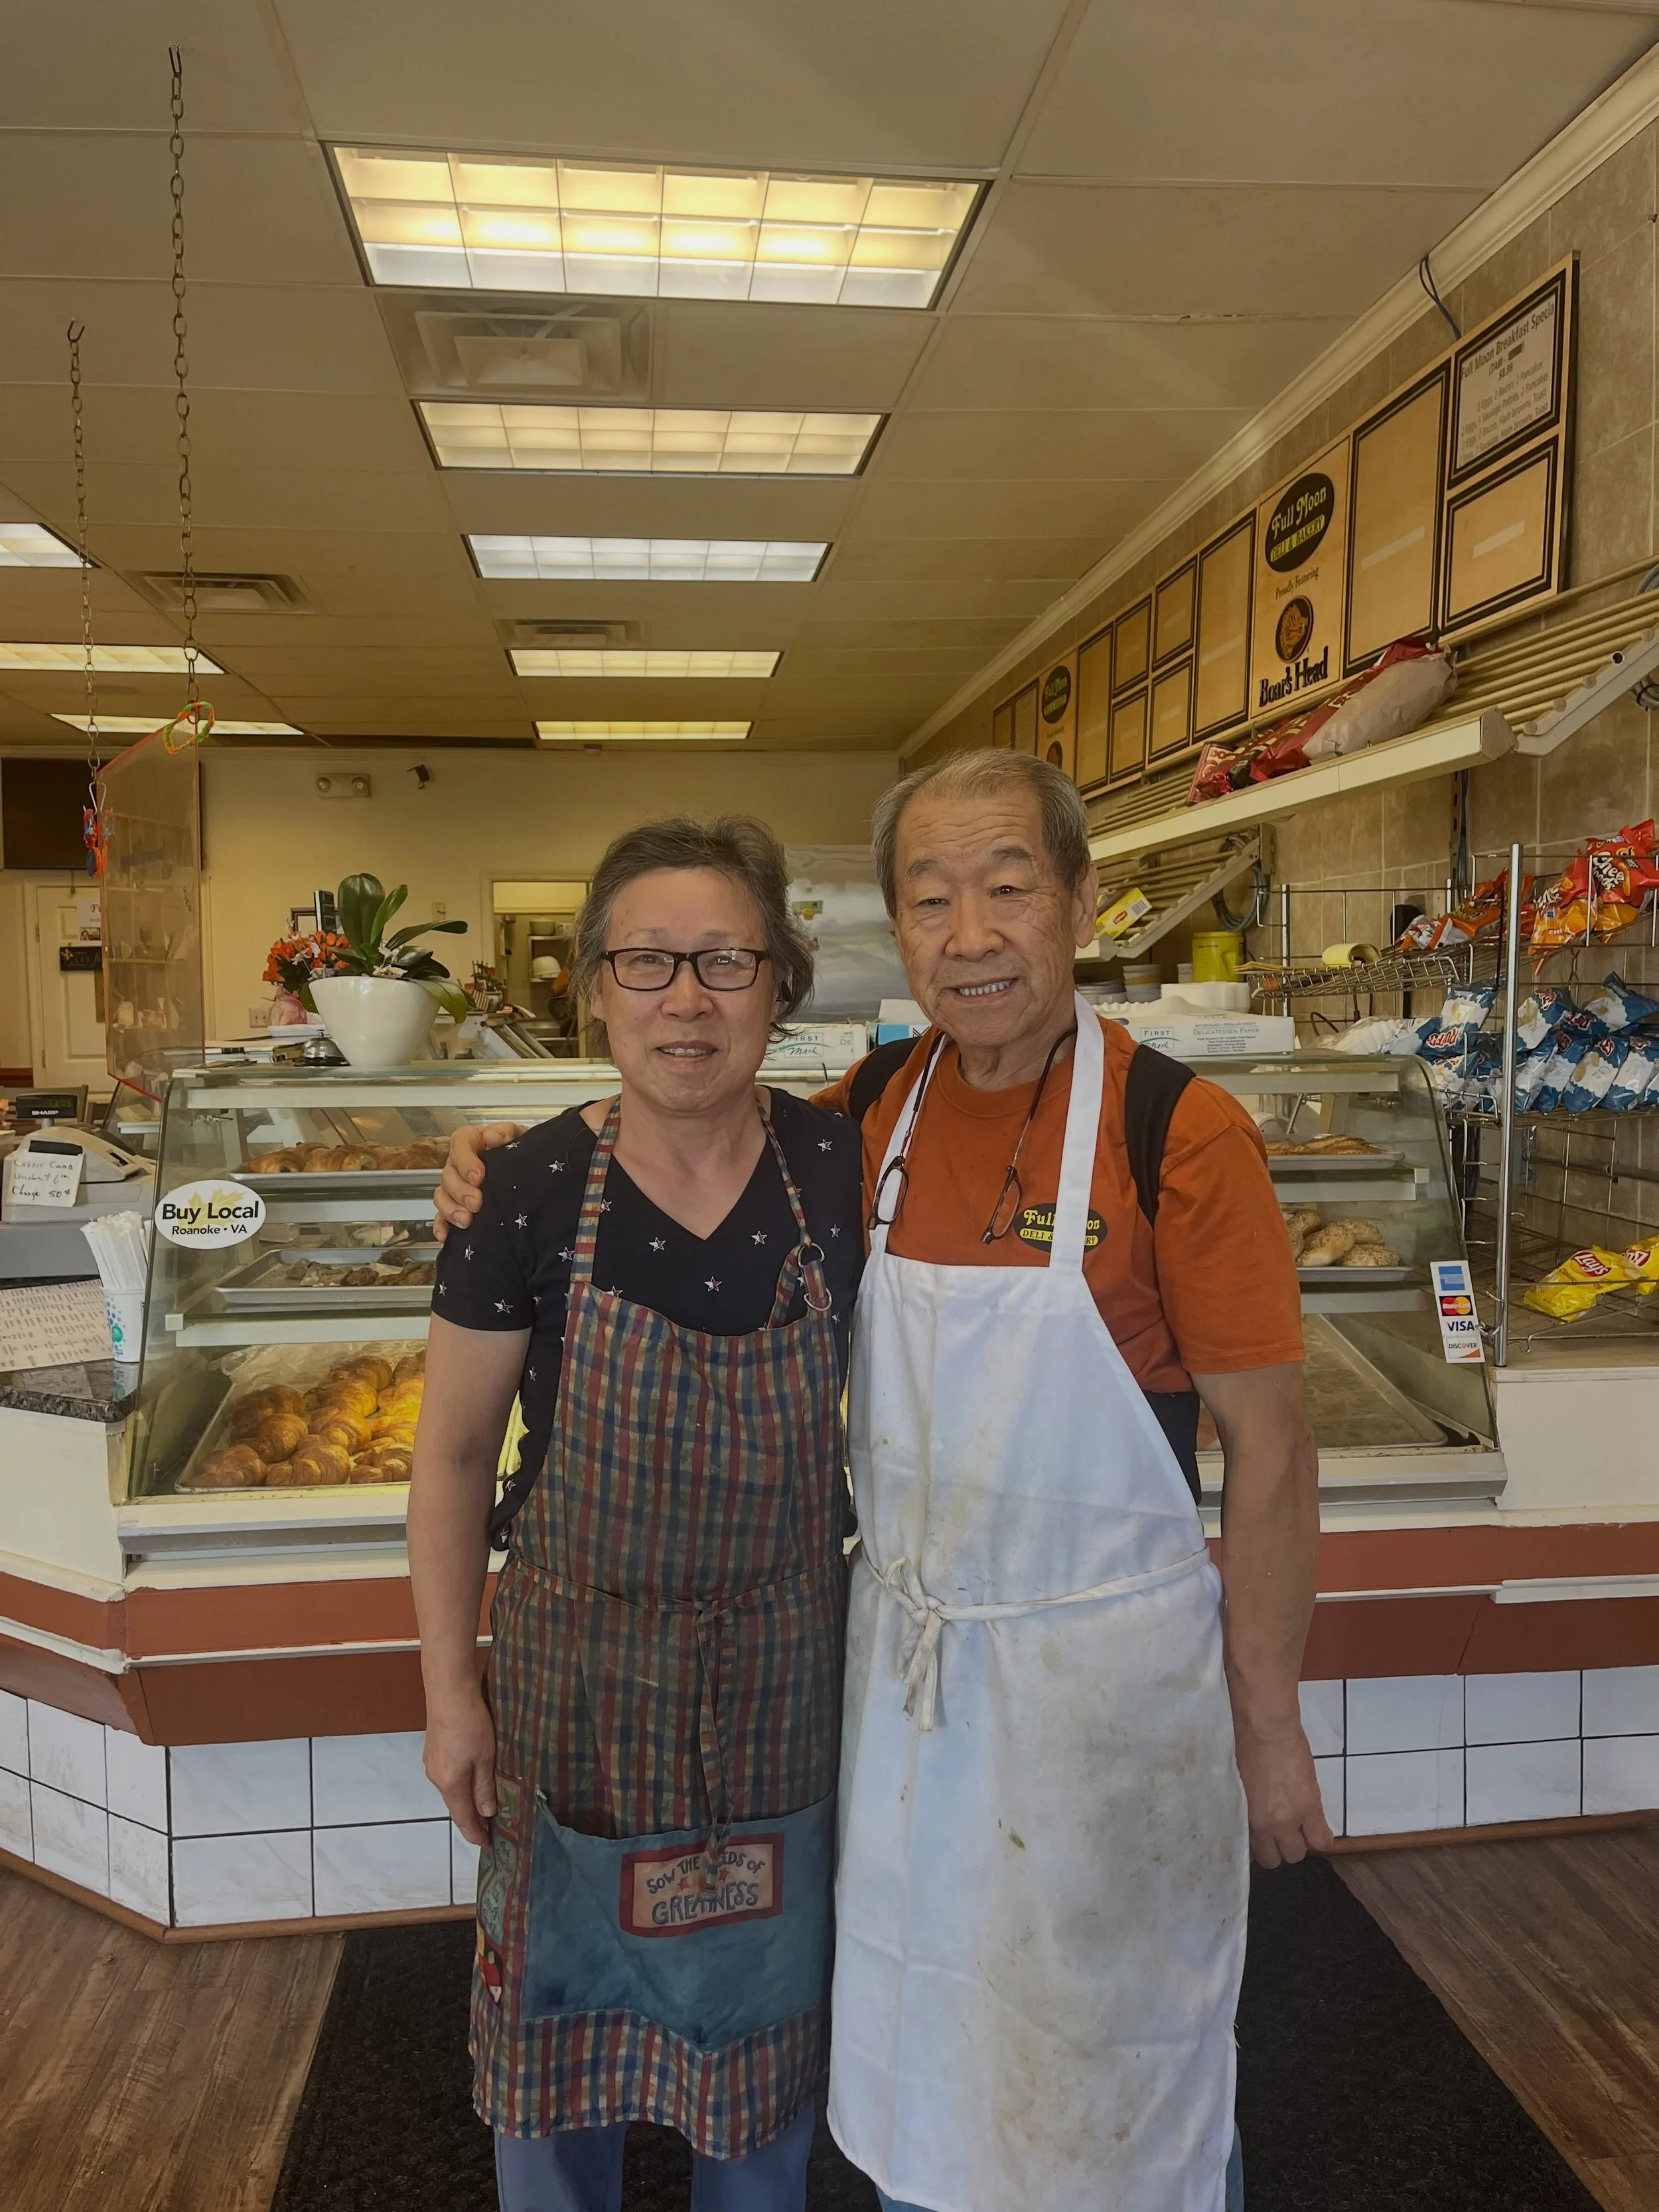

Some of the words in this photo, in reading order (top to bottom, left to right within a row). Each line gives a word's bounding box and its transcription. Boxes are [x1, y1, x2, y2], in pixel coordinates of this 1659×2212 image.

[1496, 320, 1529, 355] Breakfast
[1271, 504, 1294, 540] Full
[1296, 486, 1327, 525] Moon
[1295, 516, 1323, 546] BAKERY
[1275, 578, 1294, 600] Proudly
[1295, 567, 1319, 589] Featuring
[1259, 666, 1293, 707] Boar's
[1294, 645, 1329, 691] Head
[162, 1203, 202, 1224] Buy
[207, 1201, 259, 1219] Local
[171, 1225, 220, 1235] Roanoke
[230, 1224, 247, 1234] VA
[1023, 1229, 1044, 1239] DELI
[1447, 1321, 1475, 1331] VISA
[646, 1868, 676, 1894] SOW
[677, 1856, 701, 1875] THE
[747, 1860, 766, 1874] OF
